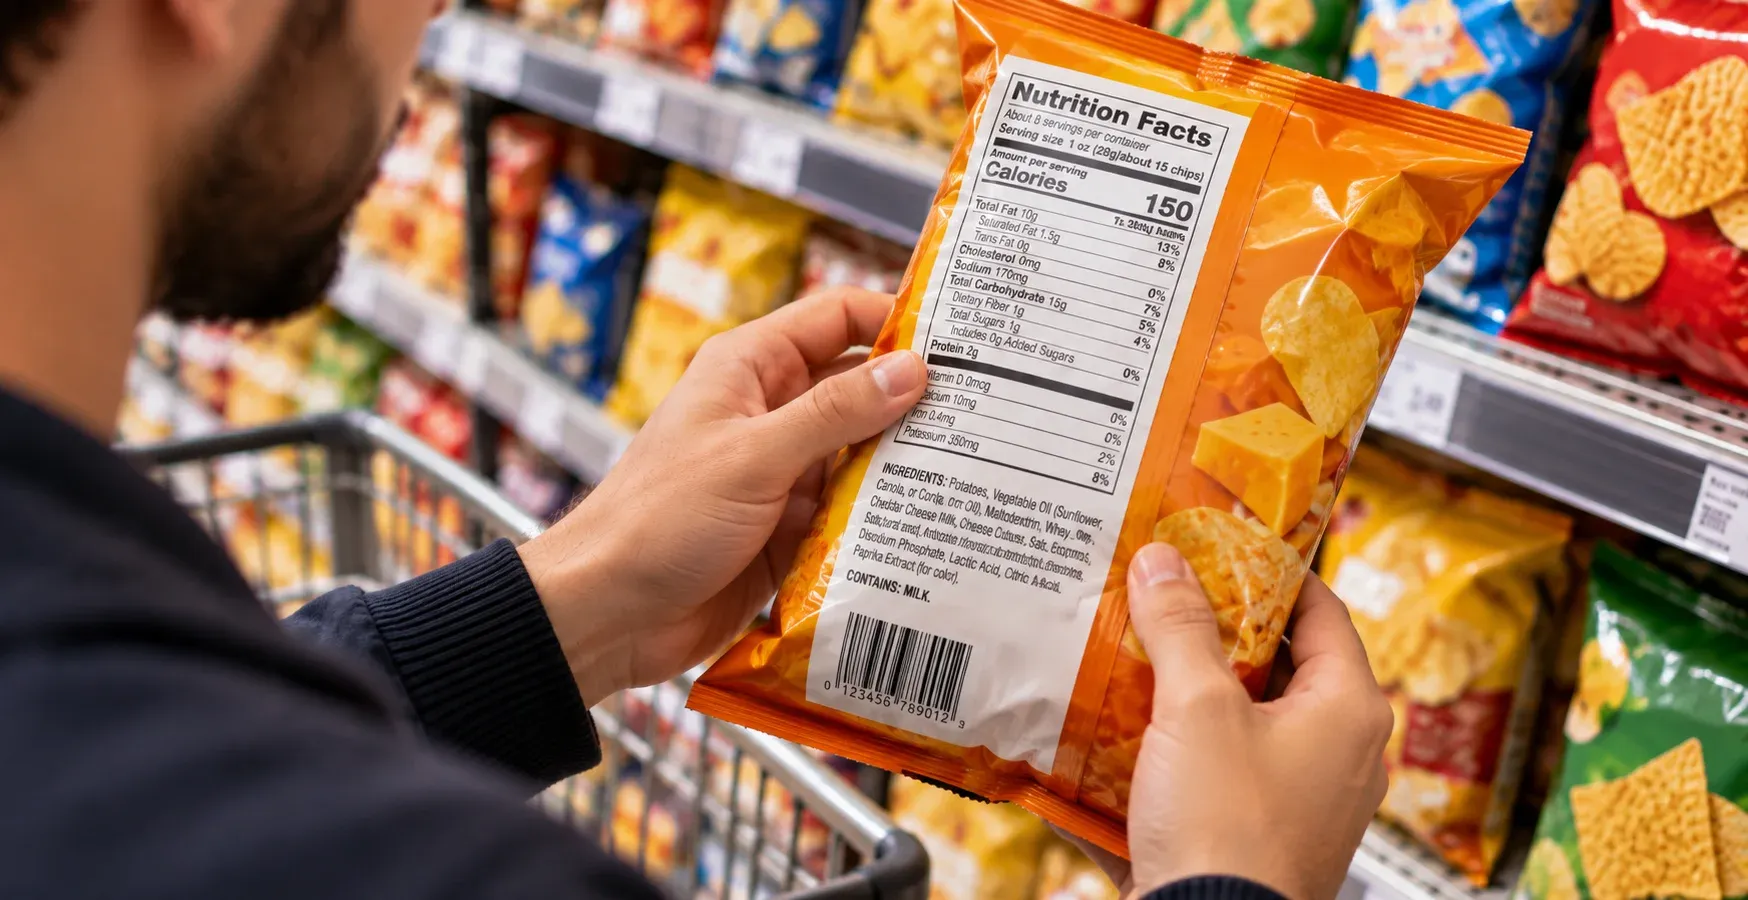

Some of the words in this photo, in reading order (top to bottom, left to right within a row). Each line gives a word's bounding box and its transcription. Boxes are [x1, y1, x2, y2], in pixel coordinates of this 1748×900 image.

[1003, 108, 1032, 123] About
[1042, 118, 1083, 135] servings
[1083, 128, 1101, 139] per
[1011, 80, 1129, 126] Nutrition
[1136, 110, 1211, 147] Facts
[989, 148, 1027, 163] Amount
[1028, 158, 1045, 167] per
[1045, 161, 1088, 179] serving
[998, 122, 1039, 142] Serving
[1041, 133, 1063, 146] size
[1069, 139, 1074, 148] 1
[1076, 142, 1090, 152] oz
[1092, 144, 1152, 168] (28g/about
[1155, 160, 1168, 172] 15
[1170, 165, 1204, 183] chips)
[985, 160, 1067, 192] Calories
[1146, 193, 1193, 222] 150
[974, 229, 998, 244] Trans
[998, 234, 1015, 247] Fat
[1016, 239, 1029, 252] 0g
[975, 198, 999, 212] Total
[1000, 203, 1018, 216] Fat
[1021, 208, 1038, 223] 10g
[1157, 241, 1180, 256] 13%
[1021, 223, 1038, 236] Fat
[1040, 228, 1060, 244] 1.5g
[1157, 257, 1175, 271] 8%
[953, 258, 991, 275] Sodium
[996, 266, 1028, 285] 170mg
[1143, 303, 1160, 318] 7%
[959, 243, 1016, 263] Cholesterol
[1018, 256, 1041, 271] 0mg
[1147, 288, 1165, 301] 0%
[949, 307, 971, 320] Total
[972, 311, 1005, 328] Sugars
[1009, 320, 1020, 334] 1g
[950, 274, 973, 287] Total
[974, 278, 1045, 303] Carbohydrate
[1049, 296, 1067, 311] 15g
[1138, 319, 1155, 333] 5%
[952, 290, 983, 308] Dietary
[1013, 304, 1025, 318] 1g
[1133, 336, 1151, 349] 4%
[930, 339, 963, 354] Protein
[965, 345, 978, 360] 2g
[950, 324, 987, 341] Includes
[989, 332, 1002, 346] 0g
[1003, 336, 1037, 353] Added
[1038, 345, 1074, 363] Sugars
[1122, 367, 1140, 381] 0%
[920, 388, 950, 402] alcium
[953, 394, 977, 410] 10mg
[1104, 432, 1121, 446] 0%
[955, 373, 963, 385] D
[964, 375, 991, 393] 0mcg
[1109, 412, 1127, 426] 0%
[928, 409, 955, 427] 0.4mg
[1097, 451, 1115, 466] 2%
[882, 461, 947, 486] INGREDIENTS:
[948, 476, 989, 500] Potatoes,
[993, 488, 1036, 510] Vegetable
[1053, 504, 1103, 531] (Sunflower,
[907, 487, 918, 497] or
[1091, 471, 1109, 486] 8%
[904, 503, 937, 521] Cheese
[852, 543, 883, 562] Paprika
[884, 552, 916, 571] Extract
[897, 537, 945, 563] Phosphate,
[948, 551, 977, 569] Lactic
[978, 560, 1000, 578] Acid,
[846, 569, 901, 594] CONTAINS:
[902, 584, 930, 602] MILK.
[824, 680, 831, 690] 0
[843, 684, 890, 707] 123456
[900, 700, 949, 723] 789012
